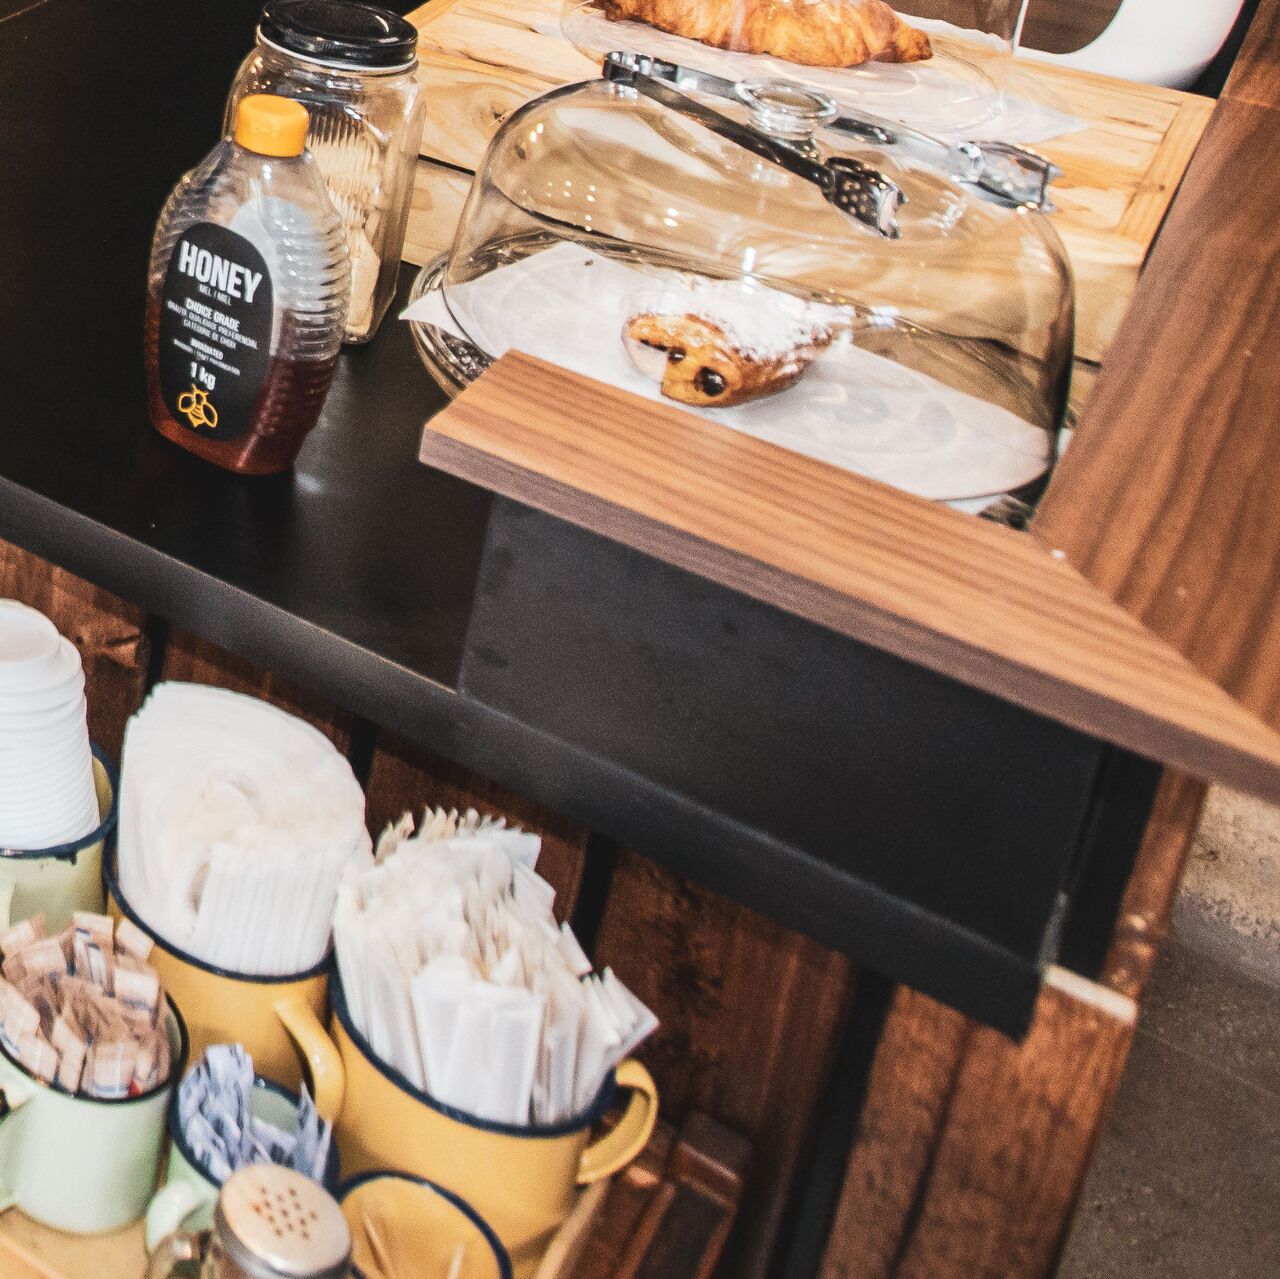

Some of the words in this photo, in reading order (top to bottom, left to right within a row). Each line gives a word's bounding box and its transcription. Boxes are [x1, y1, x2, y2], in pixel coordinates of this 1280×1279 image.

[179, 240, 263, 304] HONEY
[185, 297, 213, 320] CHOICE
[213, 310, 241, 333] GRADE
[190, 361, 198, 378] 1
[198, 366, 217, 391] kg
